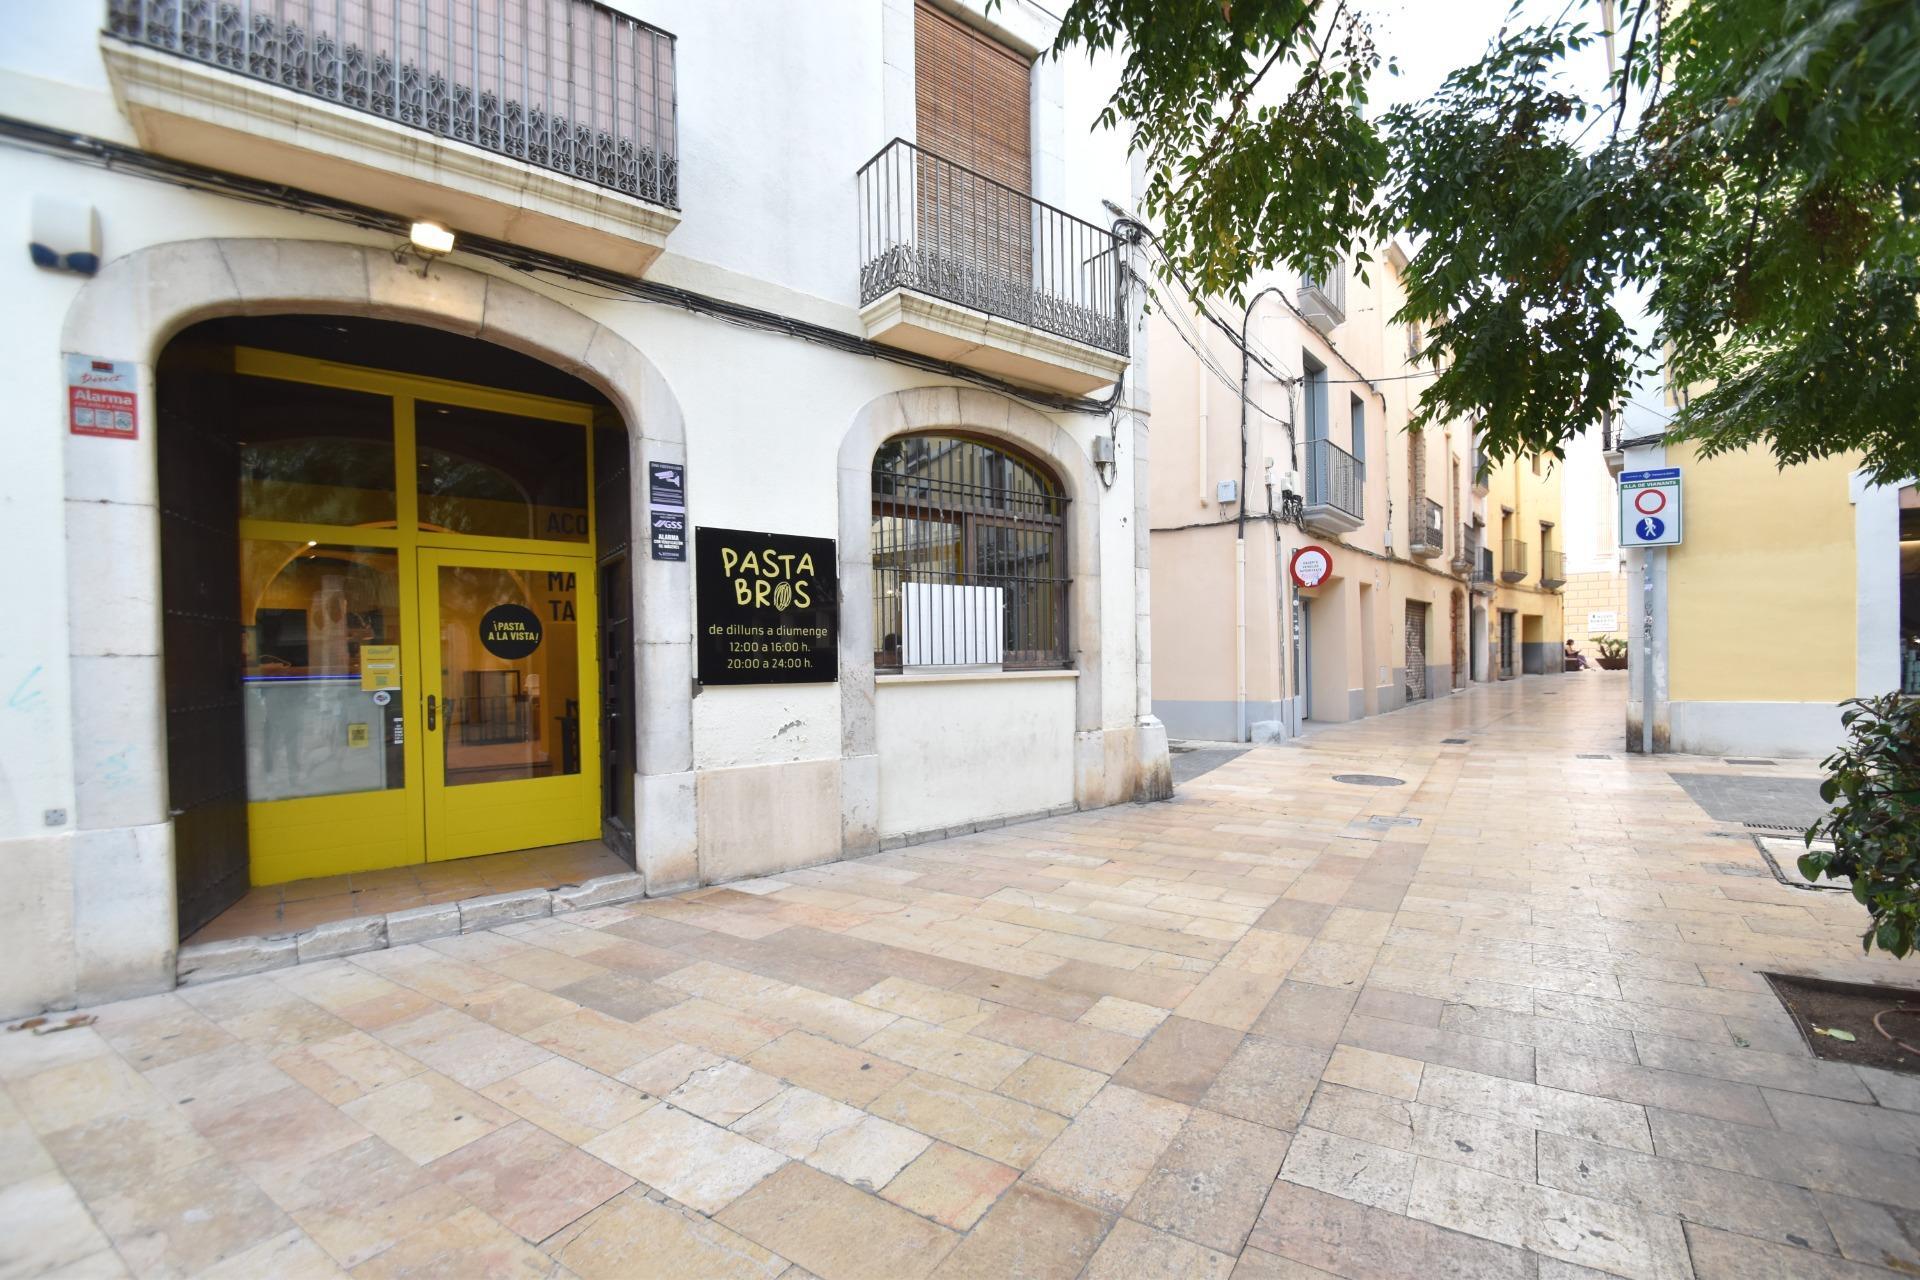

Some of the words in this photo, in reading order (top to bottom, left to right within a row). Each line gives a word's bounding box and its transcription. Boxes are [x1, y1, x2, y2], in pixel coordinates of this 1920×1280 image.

[75, 390, 132, 405] Alarma
[721, 547, 815, 580] PASTA
[734, 578, 811, 612] BROS
[548, 600, 577, 622] TA
[488, 632, 495, 641] A
[496, 632, 508, 641] LA
[708, 624, 723, 635] de
[726, 624, 765, 636] dilluns
[767, 627, 773, 636] a
[776, 625, 828, 639] diumenge
[729, 642, 759, 652] 12:00
[761, 643, 768, 652] a
[771, 642, 799, 652] 16:00
[801, 642, 811, 652] h.
[727, 658, 760, 669] 20:00
[762, 660, 769, 669] a
[772, 658, 801, 669] 24:00
[804, 658, 813, 669] h.
